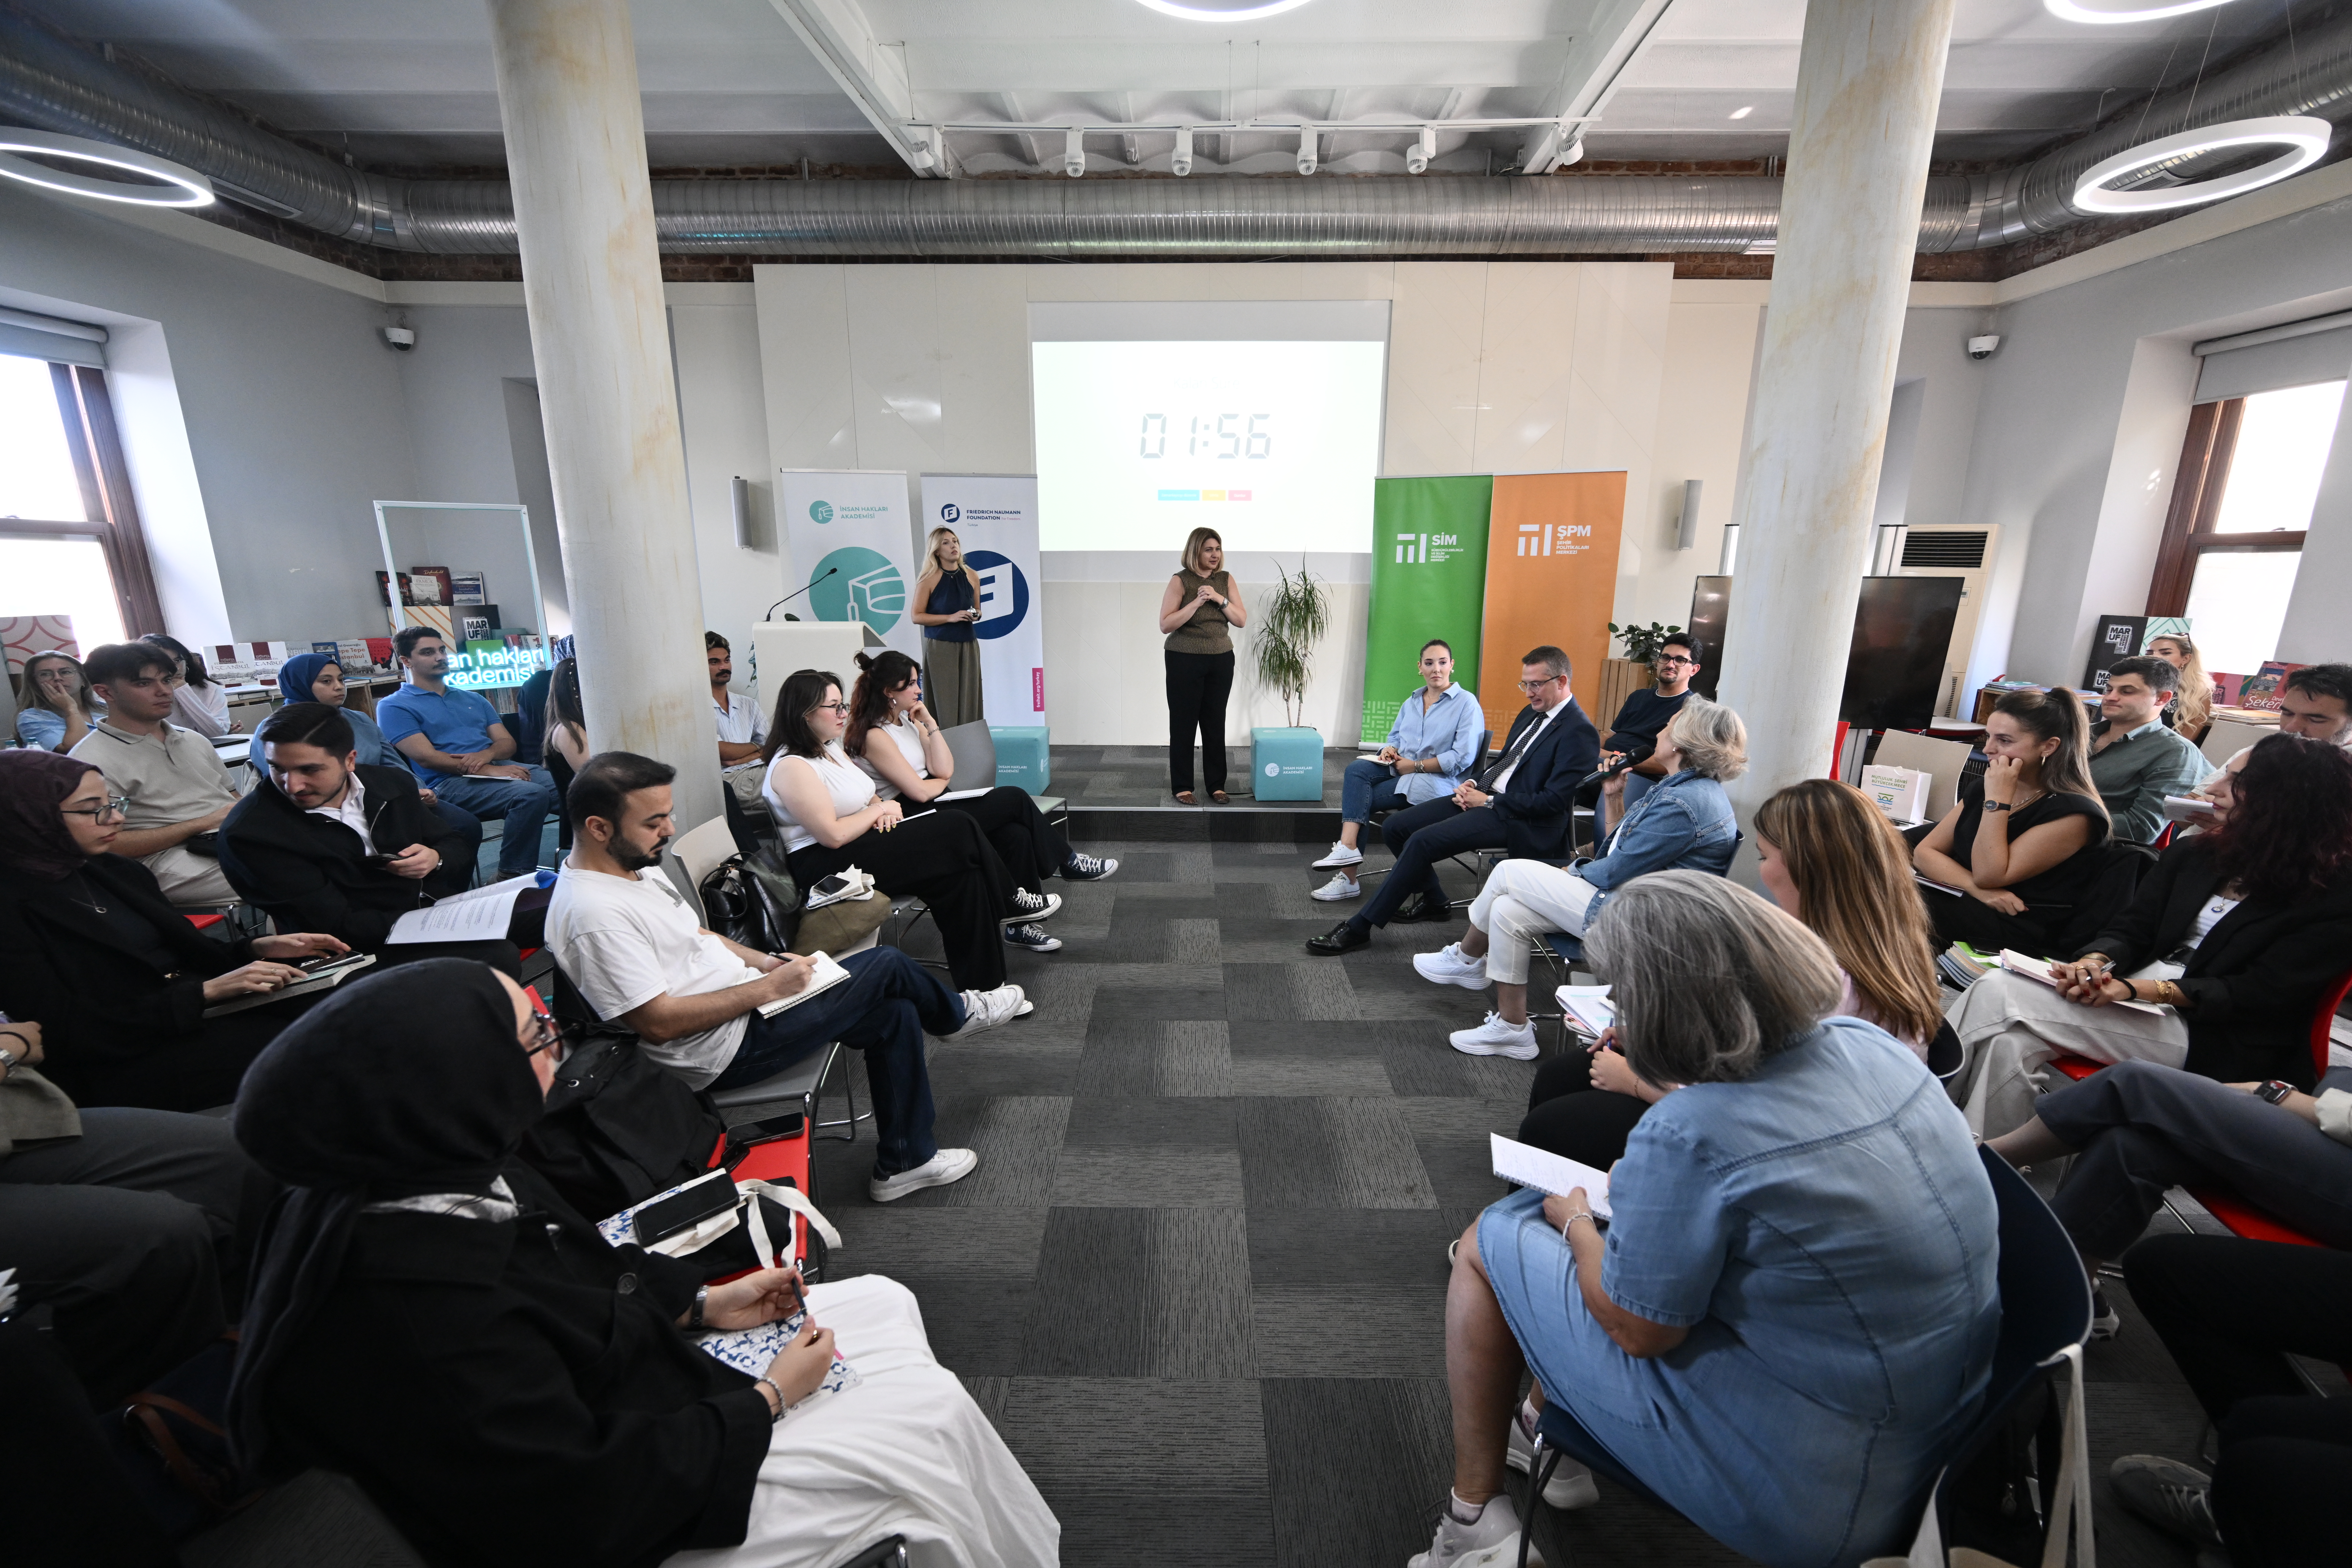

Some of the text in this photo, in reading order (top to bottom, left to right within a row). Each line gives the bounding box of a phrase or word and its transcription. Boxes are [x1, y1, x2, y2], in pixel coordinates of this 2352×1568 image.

[1140, 413, 1271, 459] 01:56
[1557, 525, 1591, 540] ŞPM
[1432, 532, 1457, 545] SİM
[466, 620, 487, 630] MAR
[468, 629, 480, 639] UF
[212, 664, 250, 672] İSTANBUL
[444, 662, 535, 685] kademisi
[1871, 779, 1905, 788] BÜYÜKÇEKMECE
